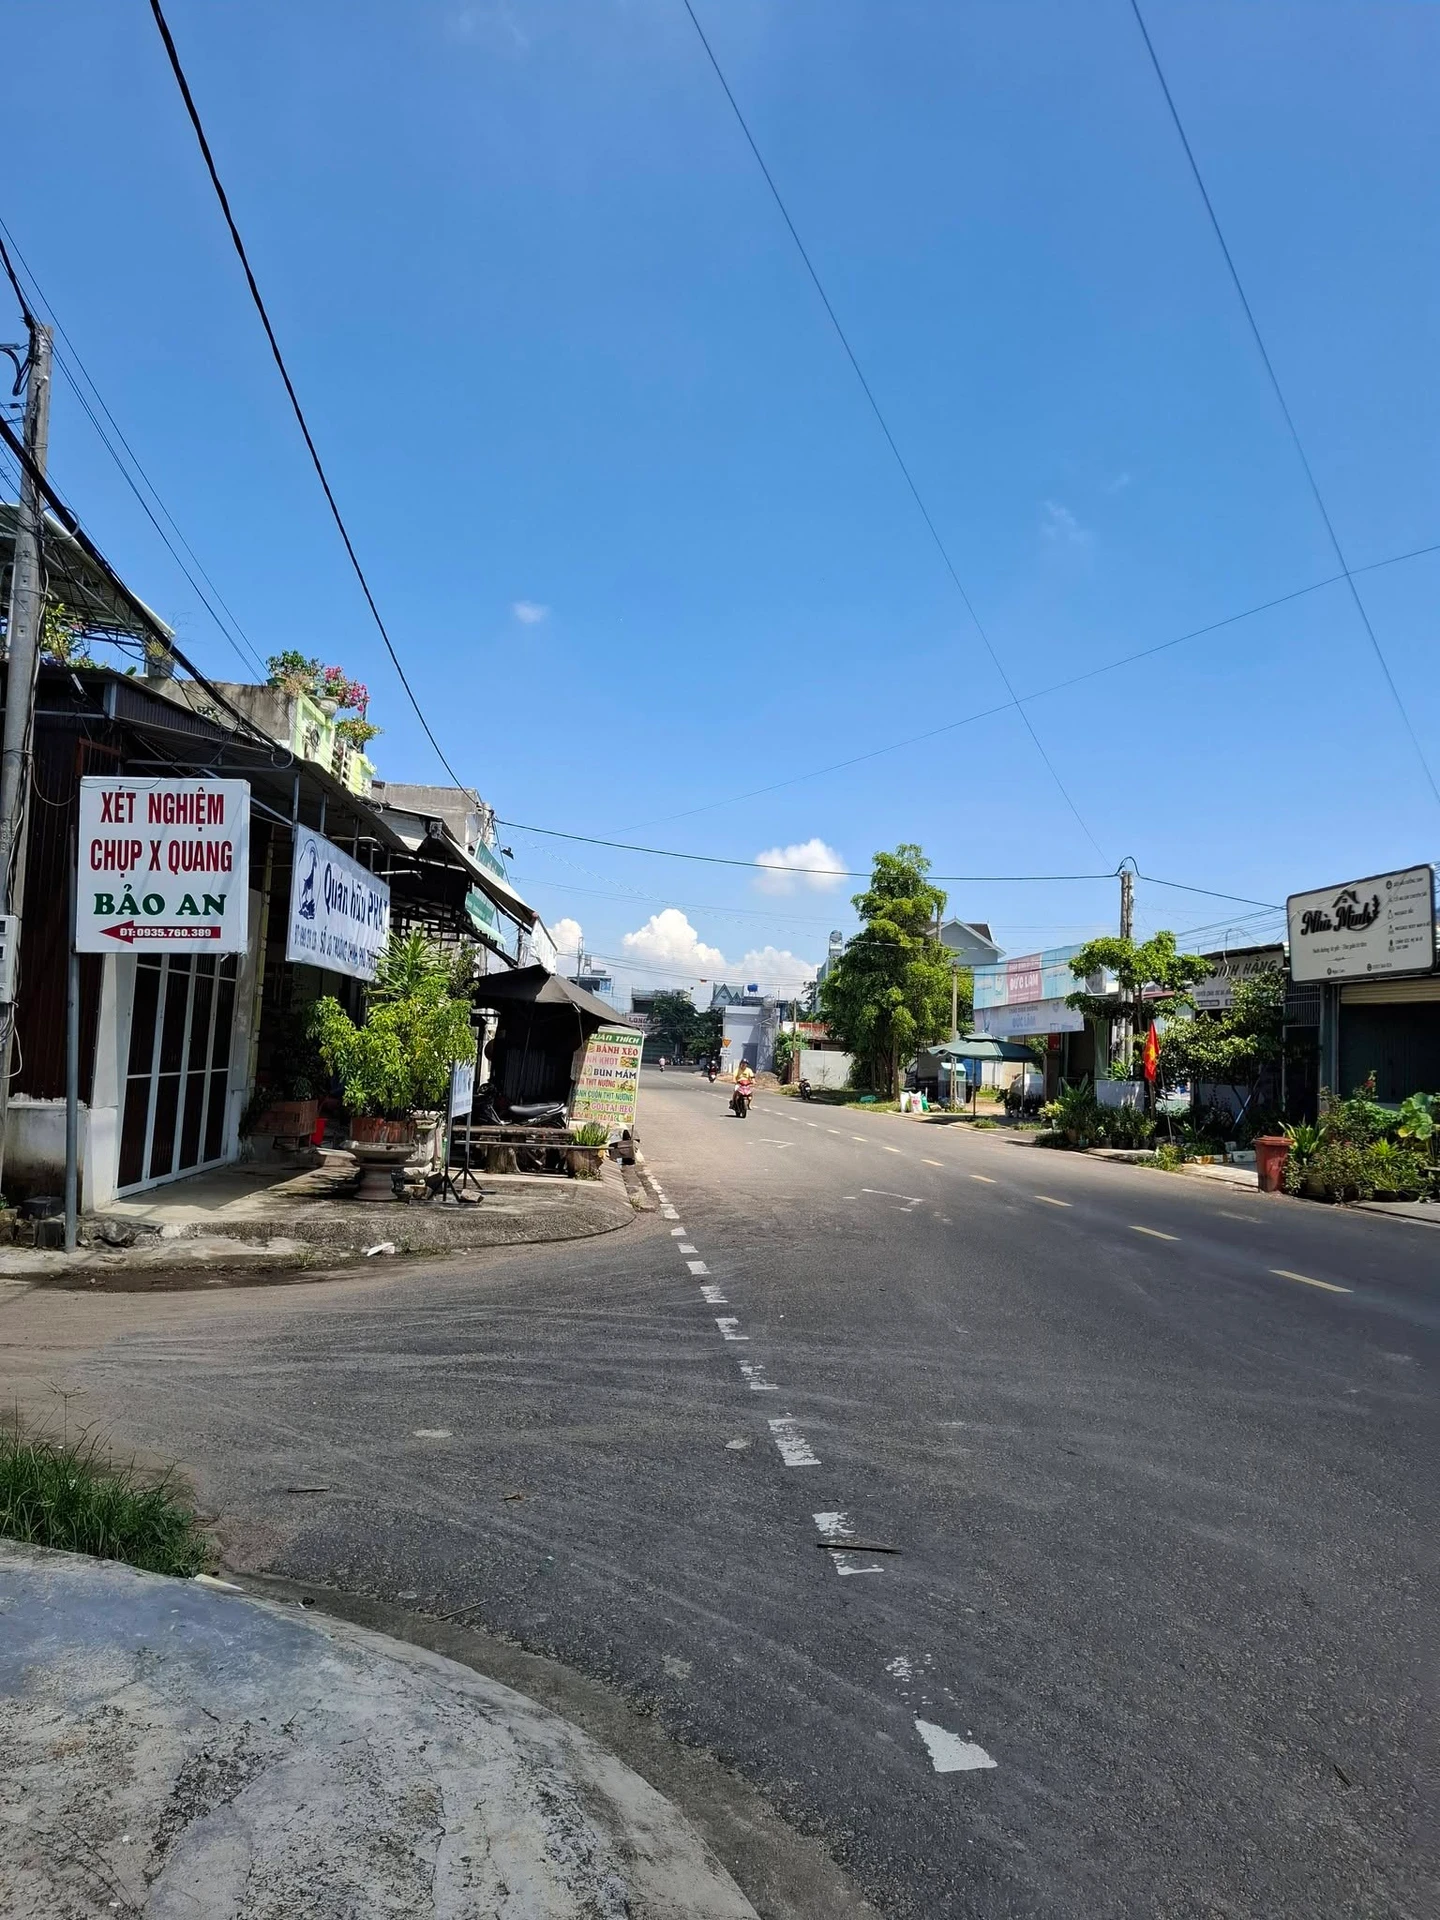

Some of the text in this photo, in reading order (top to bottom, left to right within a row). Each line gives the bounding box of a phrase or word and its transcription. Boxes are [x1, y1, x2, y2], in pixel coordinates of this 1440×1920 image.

[101, 785, 224, 832] XÉT NGHIỆM
[91, 839, 232, 878] CHỤP X QUANG
[93, 884, 227, 916] BẢO AN
[324, 863, 347, 915] Quán
[1301, 910, 1333, 936] Nhà
[596, 1044, 620, 1054] BÁNH
